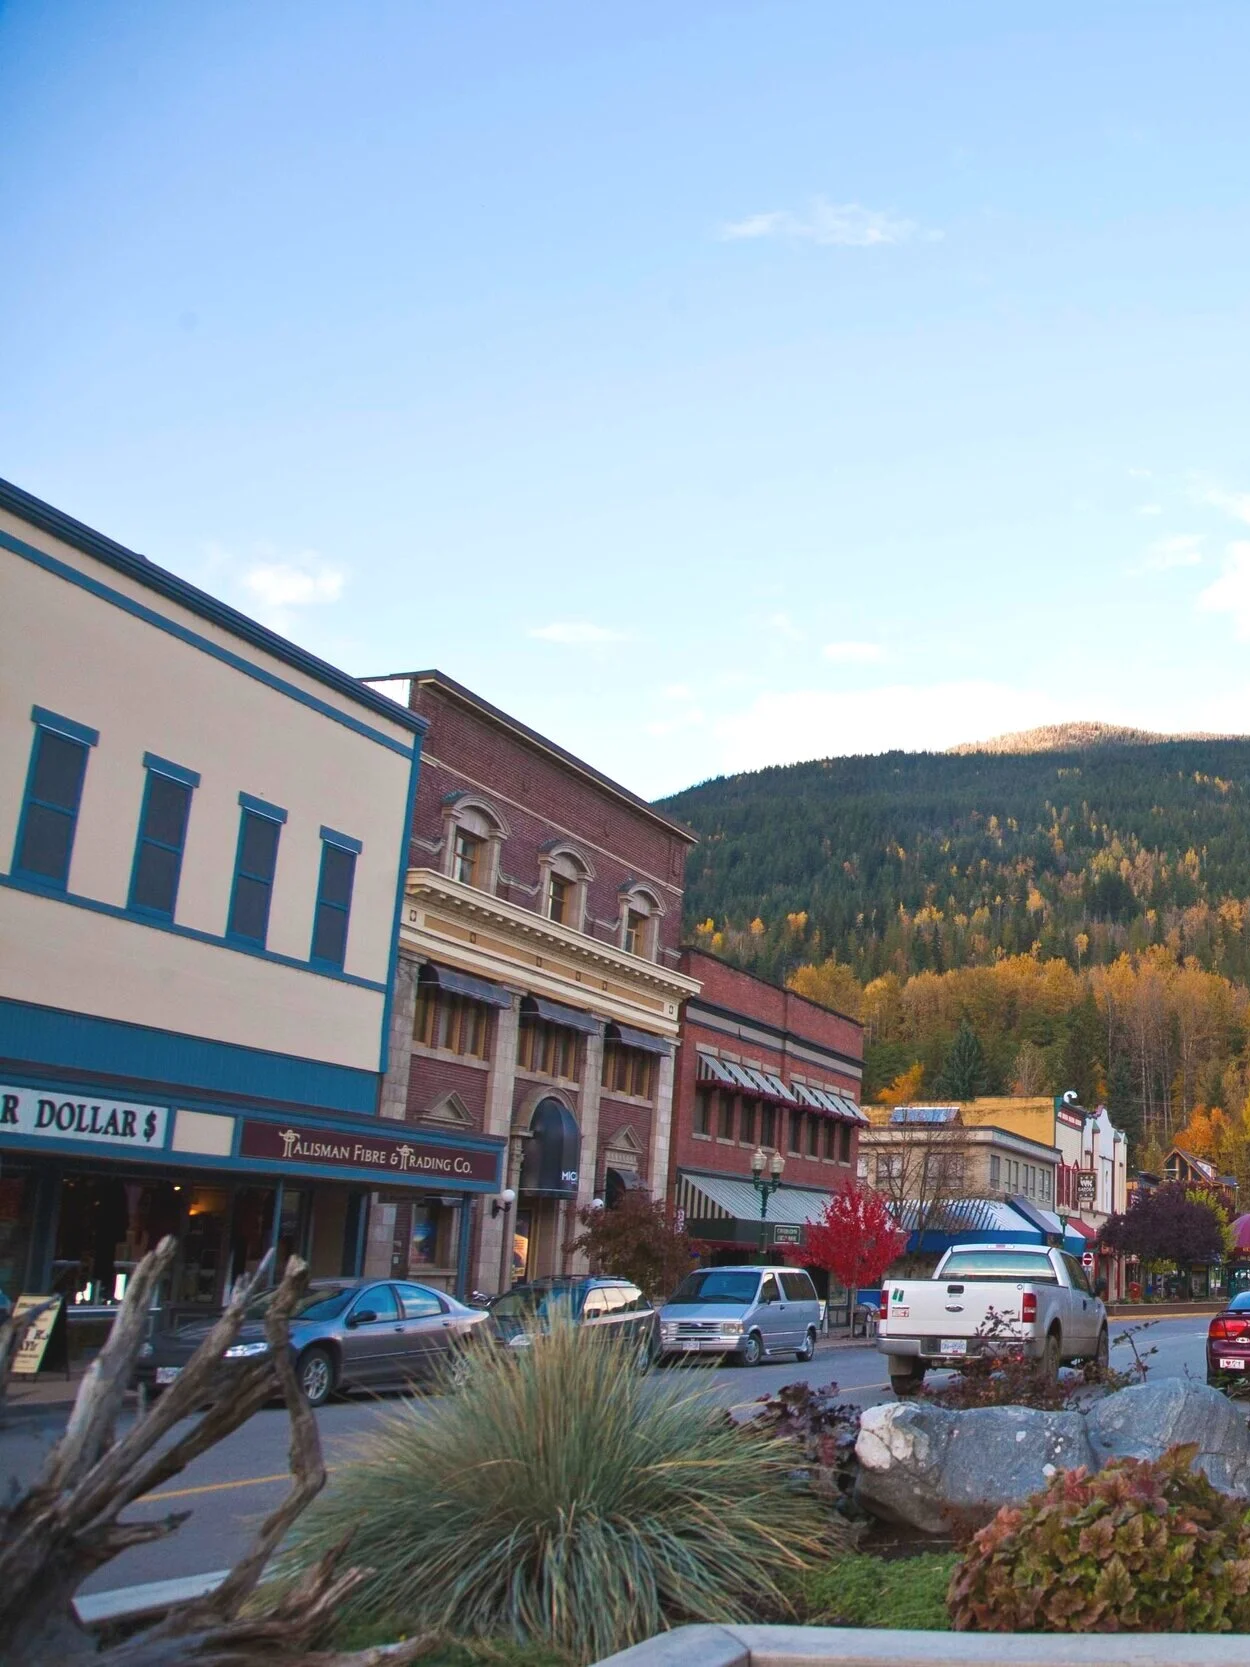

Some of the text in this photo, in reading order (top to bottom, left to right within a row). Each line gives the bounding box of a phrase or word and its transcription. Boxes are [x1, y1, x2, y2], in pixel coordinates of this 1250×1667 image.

[35, 1099, 137, 1138] DOLLAR
[143, 1110, 157, 1142] $
[390, 1152, 398, 1165] &
